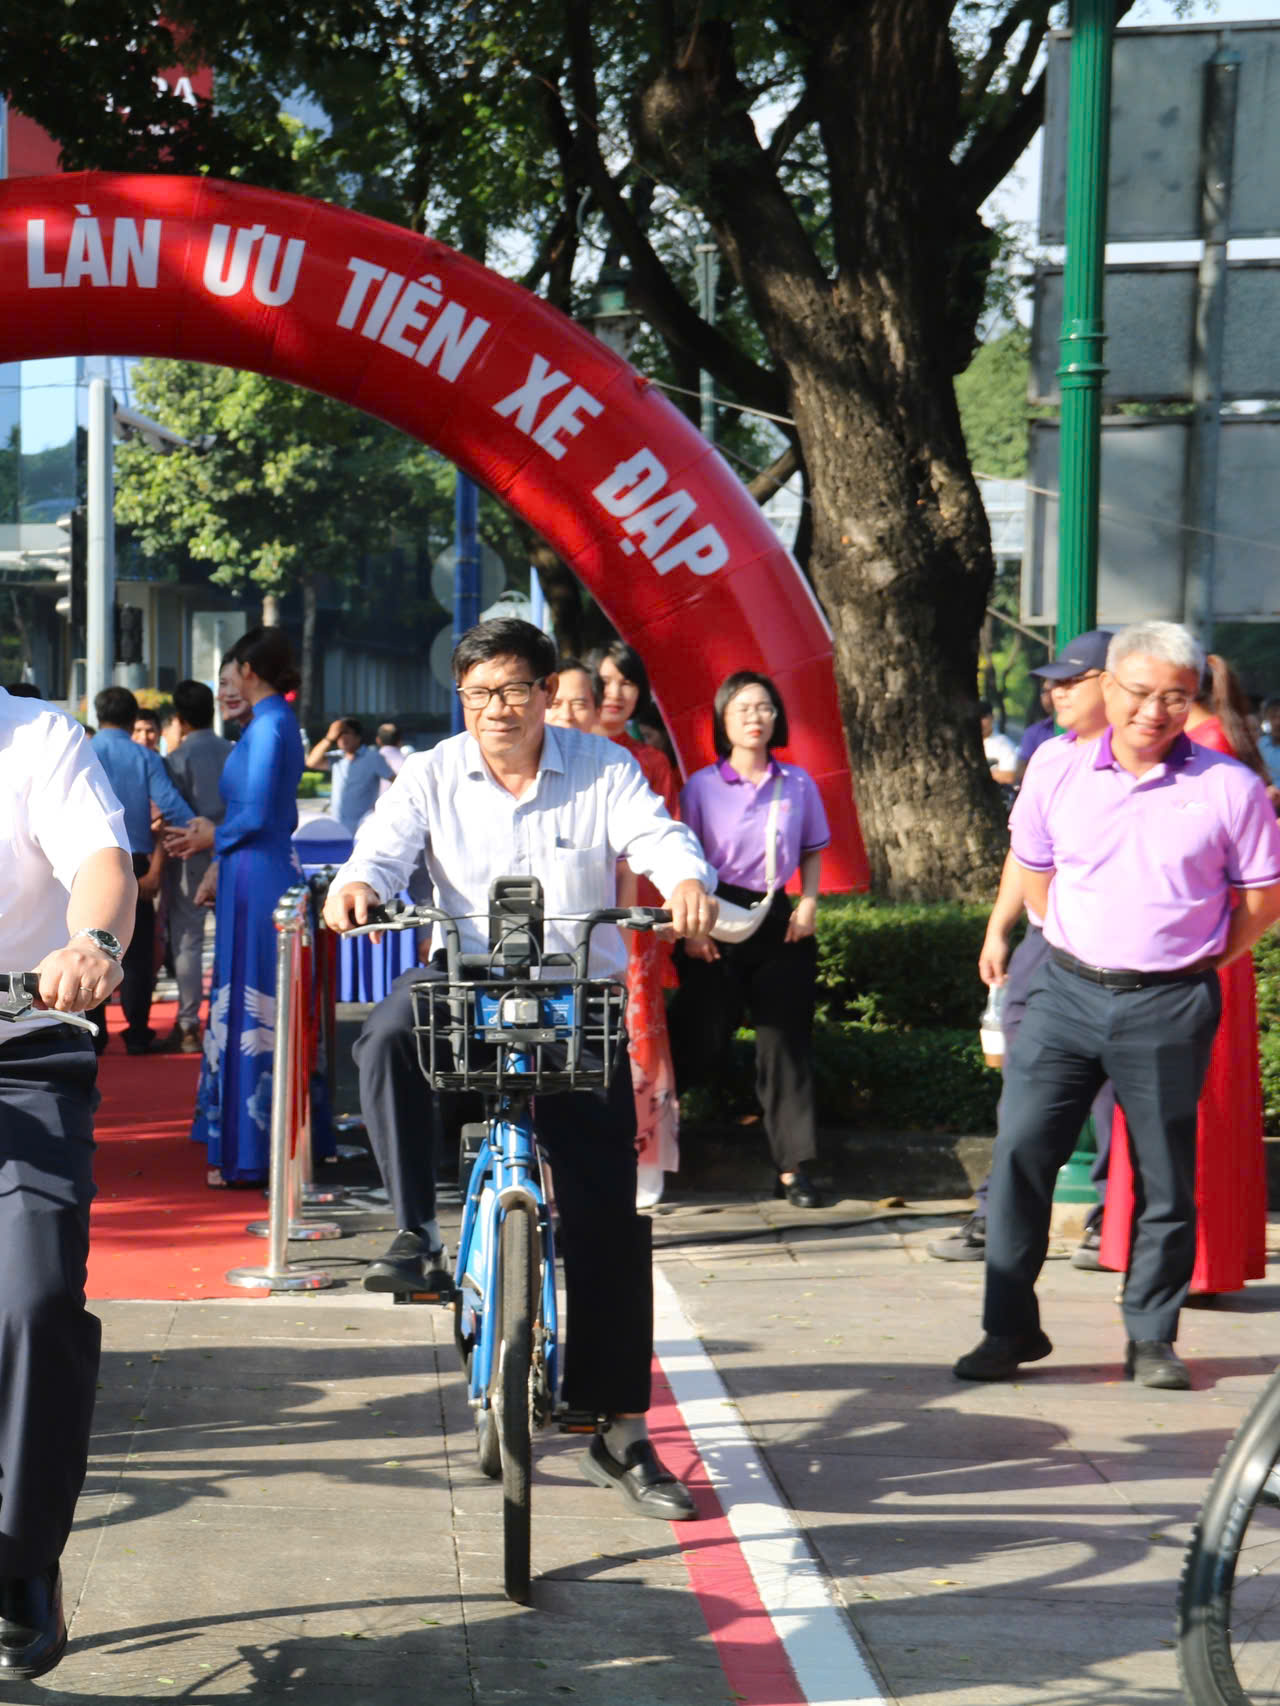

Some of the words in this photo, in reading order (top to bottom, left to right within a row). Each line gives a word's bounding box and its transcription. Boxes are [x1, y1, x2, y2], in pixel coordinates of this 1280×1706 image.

[27, 204, 162, 289] LÀN
[203, 223, 306, 306] ƯU
[337, 257, 490, 383] TIÊN
[494, 354, 604, 460] XE
[593, 447, 730, 576] ĐẠP
